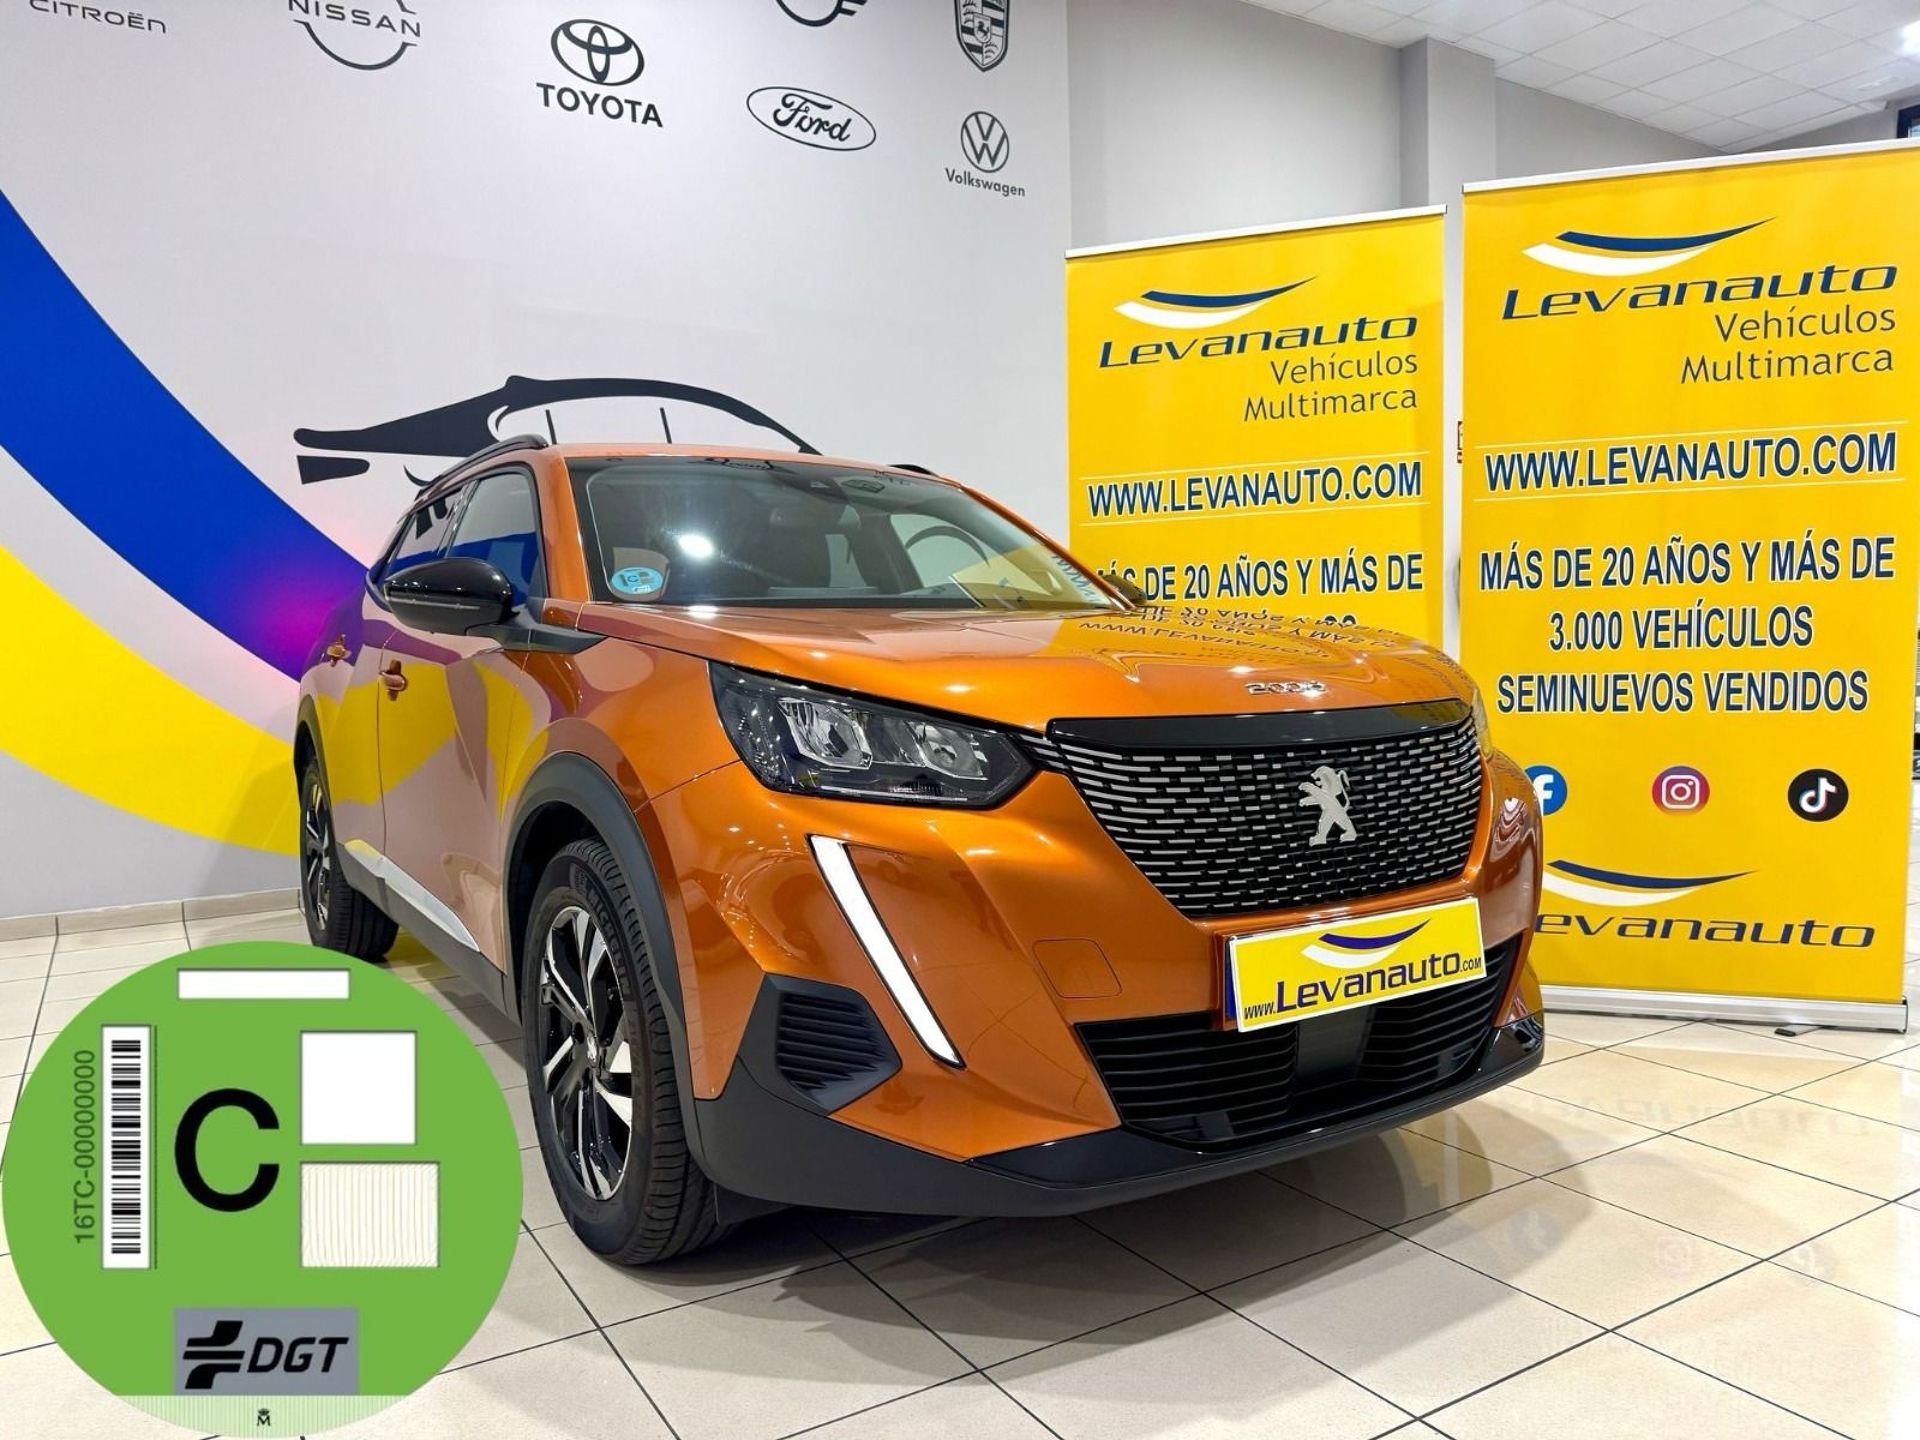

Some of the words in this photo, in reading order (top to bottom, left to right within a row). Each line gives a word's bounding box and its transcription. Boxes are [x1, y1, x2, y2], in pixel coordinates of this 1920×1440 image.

[288, 0, 421, 38] NISSAN
[536, 82, 663, 128] TOYOTA
[772, 93, 852, 142] Ford
[944, 167, 1026, 198] Volkswagen
[1502, 265, 1897, 320] Levanauto
[1099, 316, 1418, 368] Levanauto
[1715, 304, 1895, 342] Vehículos
[1270, 351, 1417, 385] Vehículos
[1681, 349, 1893, 384] Multimarca
[1243, 389, 1417, 422] Multimarca
[1485, 432, 1896, 492] WWW.LEVANAUTO.COM
[1088, 461, 1421, 517] WWW.LEVANAUTO.COM
[1144, 566, 1176, 601] DE
[1184, 564, 1210, 599] 20
[1217, 555, 1288, 598] AÑOS
[1296, 559, 1313, 595] Y
[1321, 547, 1378, 594] MÁS
[1387, 553, 1423, 591] DE
[1480, 541, 1543, 590] MÁS
[1553, 548, 1592, 588] DE
[1601, 546, 1634, 586] 20
[1642, 536, 1731, 585] AÑOS
[1741, 541, 1761, 582] Y
[1770, 529, 1840, 581] MÁS
[1851, 537, 1895, 579] DE
[1550, 610, 1623, 651] 3.000
[1632, 598, 1813, 649] VEHÍCULOS
[1497, 672, 1693, 713] SEMINUEVOS
[1703, 670, 1868, 711] VENDIDOS
[1534, 913, 1875, 948] evanauto
